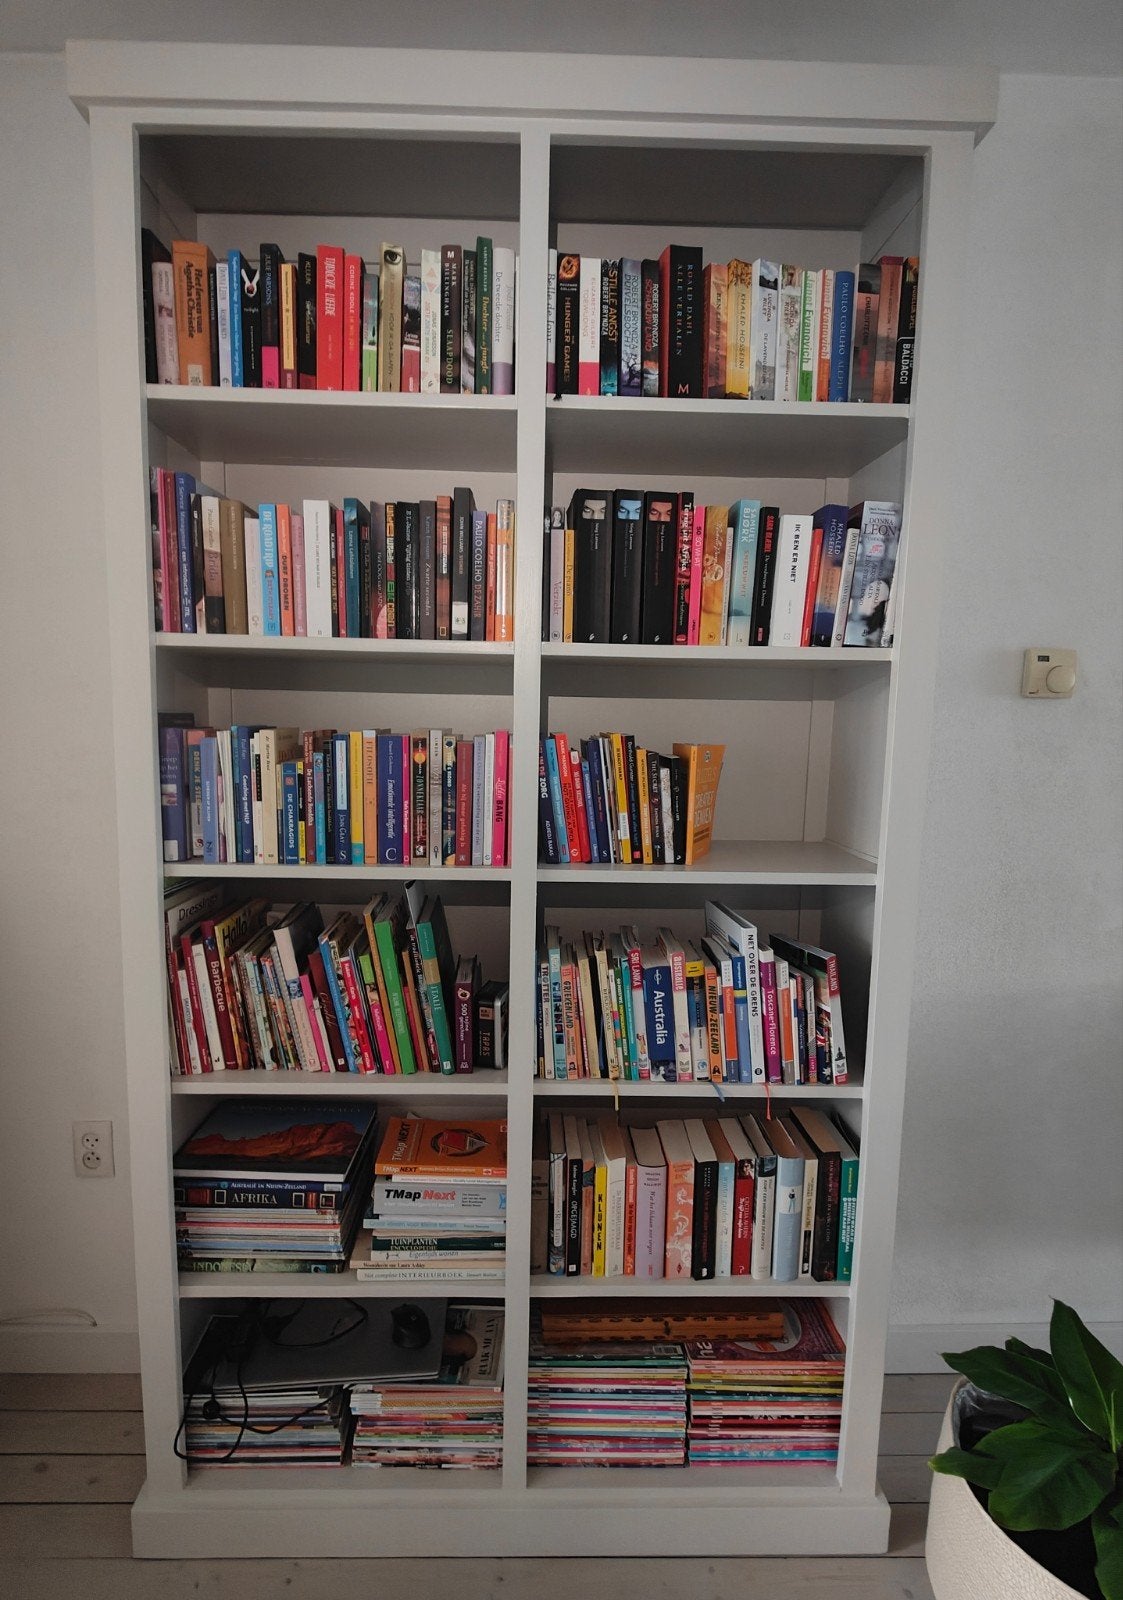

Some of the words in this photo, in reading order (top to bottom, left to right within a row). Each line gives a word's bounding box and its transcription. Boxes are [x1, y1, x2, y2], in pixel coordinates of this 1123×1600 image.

[184, 261, 194, 297] Agatha
[195, 269, 203, 287] Het
[609, 270, 617, 303] STILLE
[186, 299, 195, 338] Christie
[608, 308, 617, 342] ANGST
[802, 310, 813, 363] Evanovich
[899, 344, 909, 384] BALDACCI
[682, 503, 691, 528] Terug
[741, 507, 750, 542] BJØRK
[748, 508, 756, 543] SAMUEL
[834, 523, 843, 555] KHALED
[681, 544, 689, 571] Afrika
[792, 553, 798, 563] ER
[287, 794, 293, 802] DE
[387, 779, 395, 808] Emotionele
[540, 778, 548, 799] ZORG
[496, 800, 504, 822] BANG
[631, 952, 639, 964] SRI
[210, 960, 226, 1012] Barbecue
[632, 966, 641, 986] LANKA
[750, 977, 756, 988] DE
[828, 960, 838, 991] THAILAND
[563, 981, 573, 1029] GRIEKENLAND
[654, 990, 668, 1044] Australia
[708, 985, 719, 1055] NIEUW-ZEELAND
[482, 1031, 490, 1057] TAPAS
[232, 1194, 278, 1204] AFRIKA
[384, 1189, 422, 1201] TMap
[422, 1190, 456, 1200] Next
